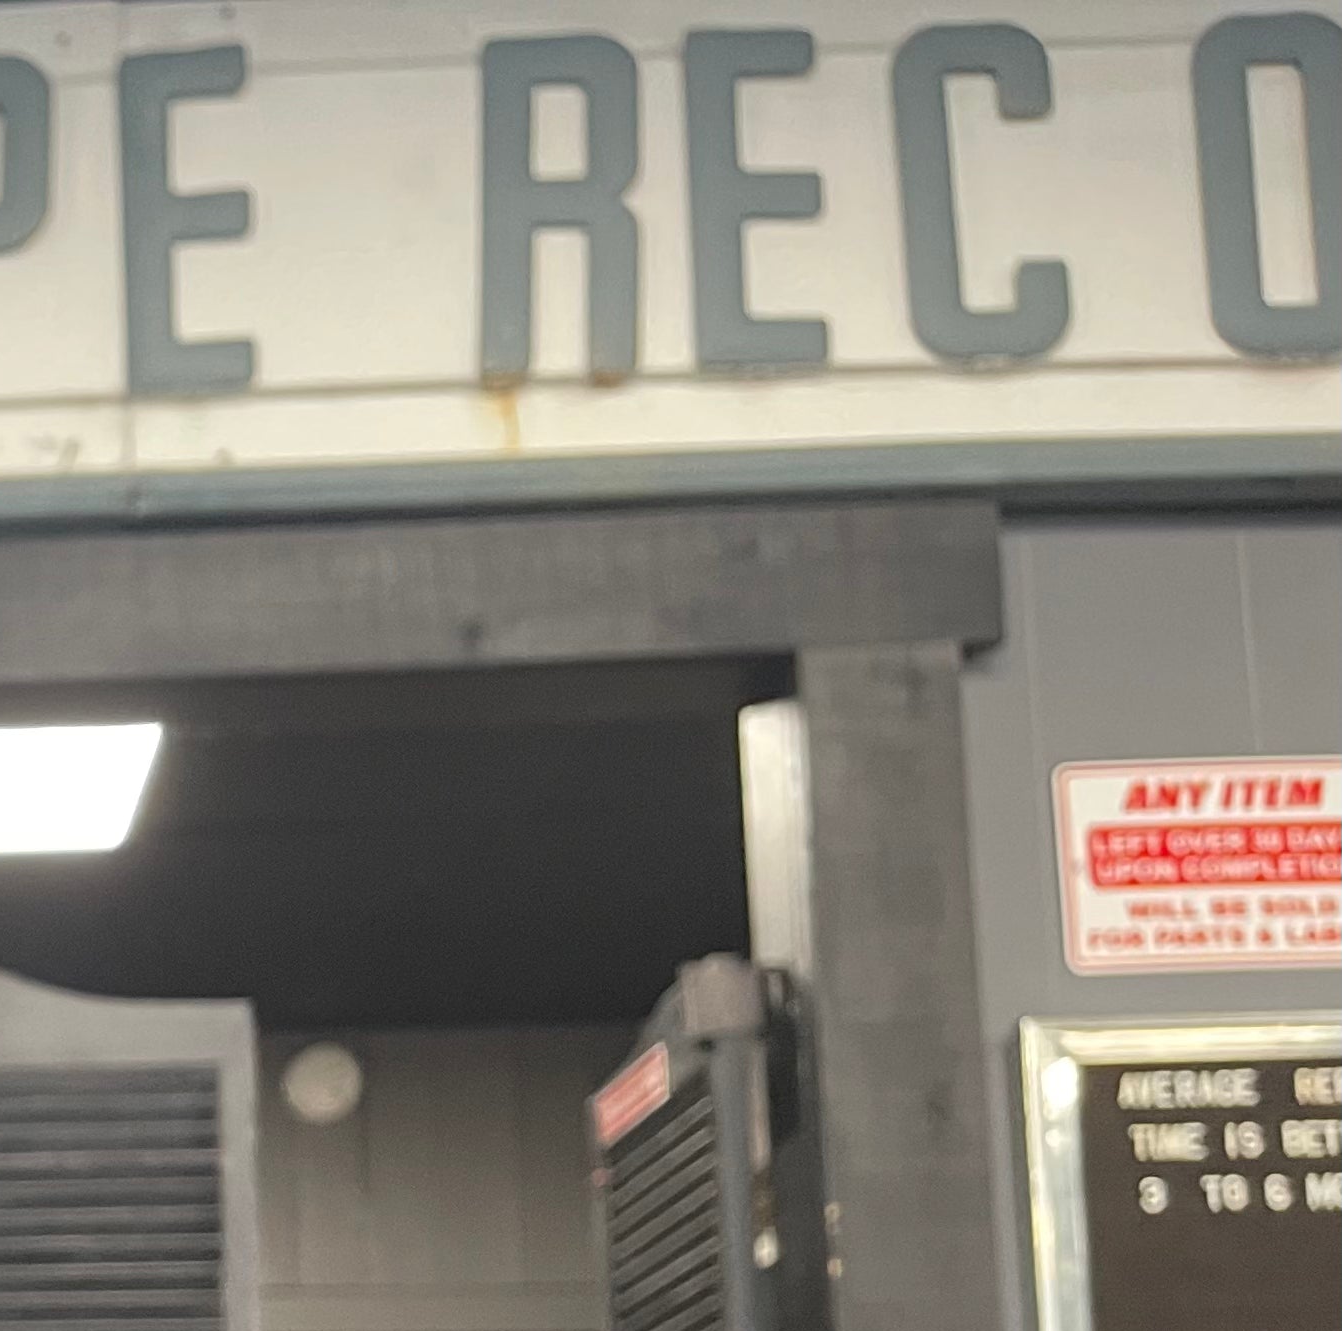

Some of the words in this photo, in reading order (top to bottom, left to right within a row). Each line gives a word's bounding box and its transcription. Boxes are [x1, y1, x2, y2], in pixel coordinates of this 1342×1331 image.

[481, 12, 1342, 386] RECO
[1126, 779, 1207, 810] ANY
[1223, 777, 1322, 807] ITEM
[1117, 1067, 1262, 1110] AVERAGE
[1128, 1121, 1210, 1162] TIME
[1224, 1121, 1264, 1160] IS
[1138, 1176, 1167, 1215] 3
[1200, 1173, 1249, 1213] TO
